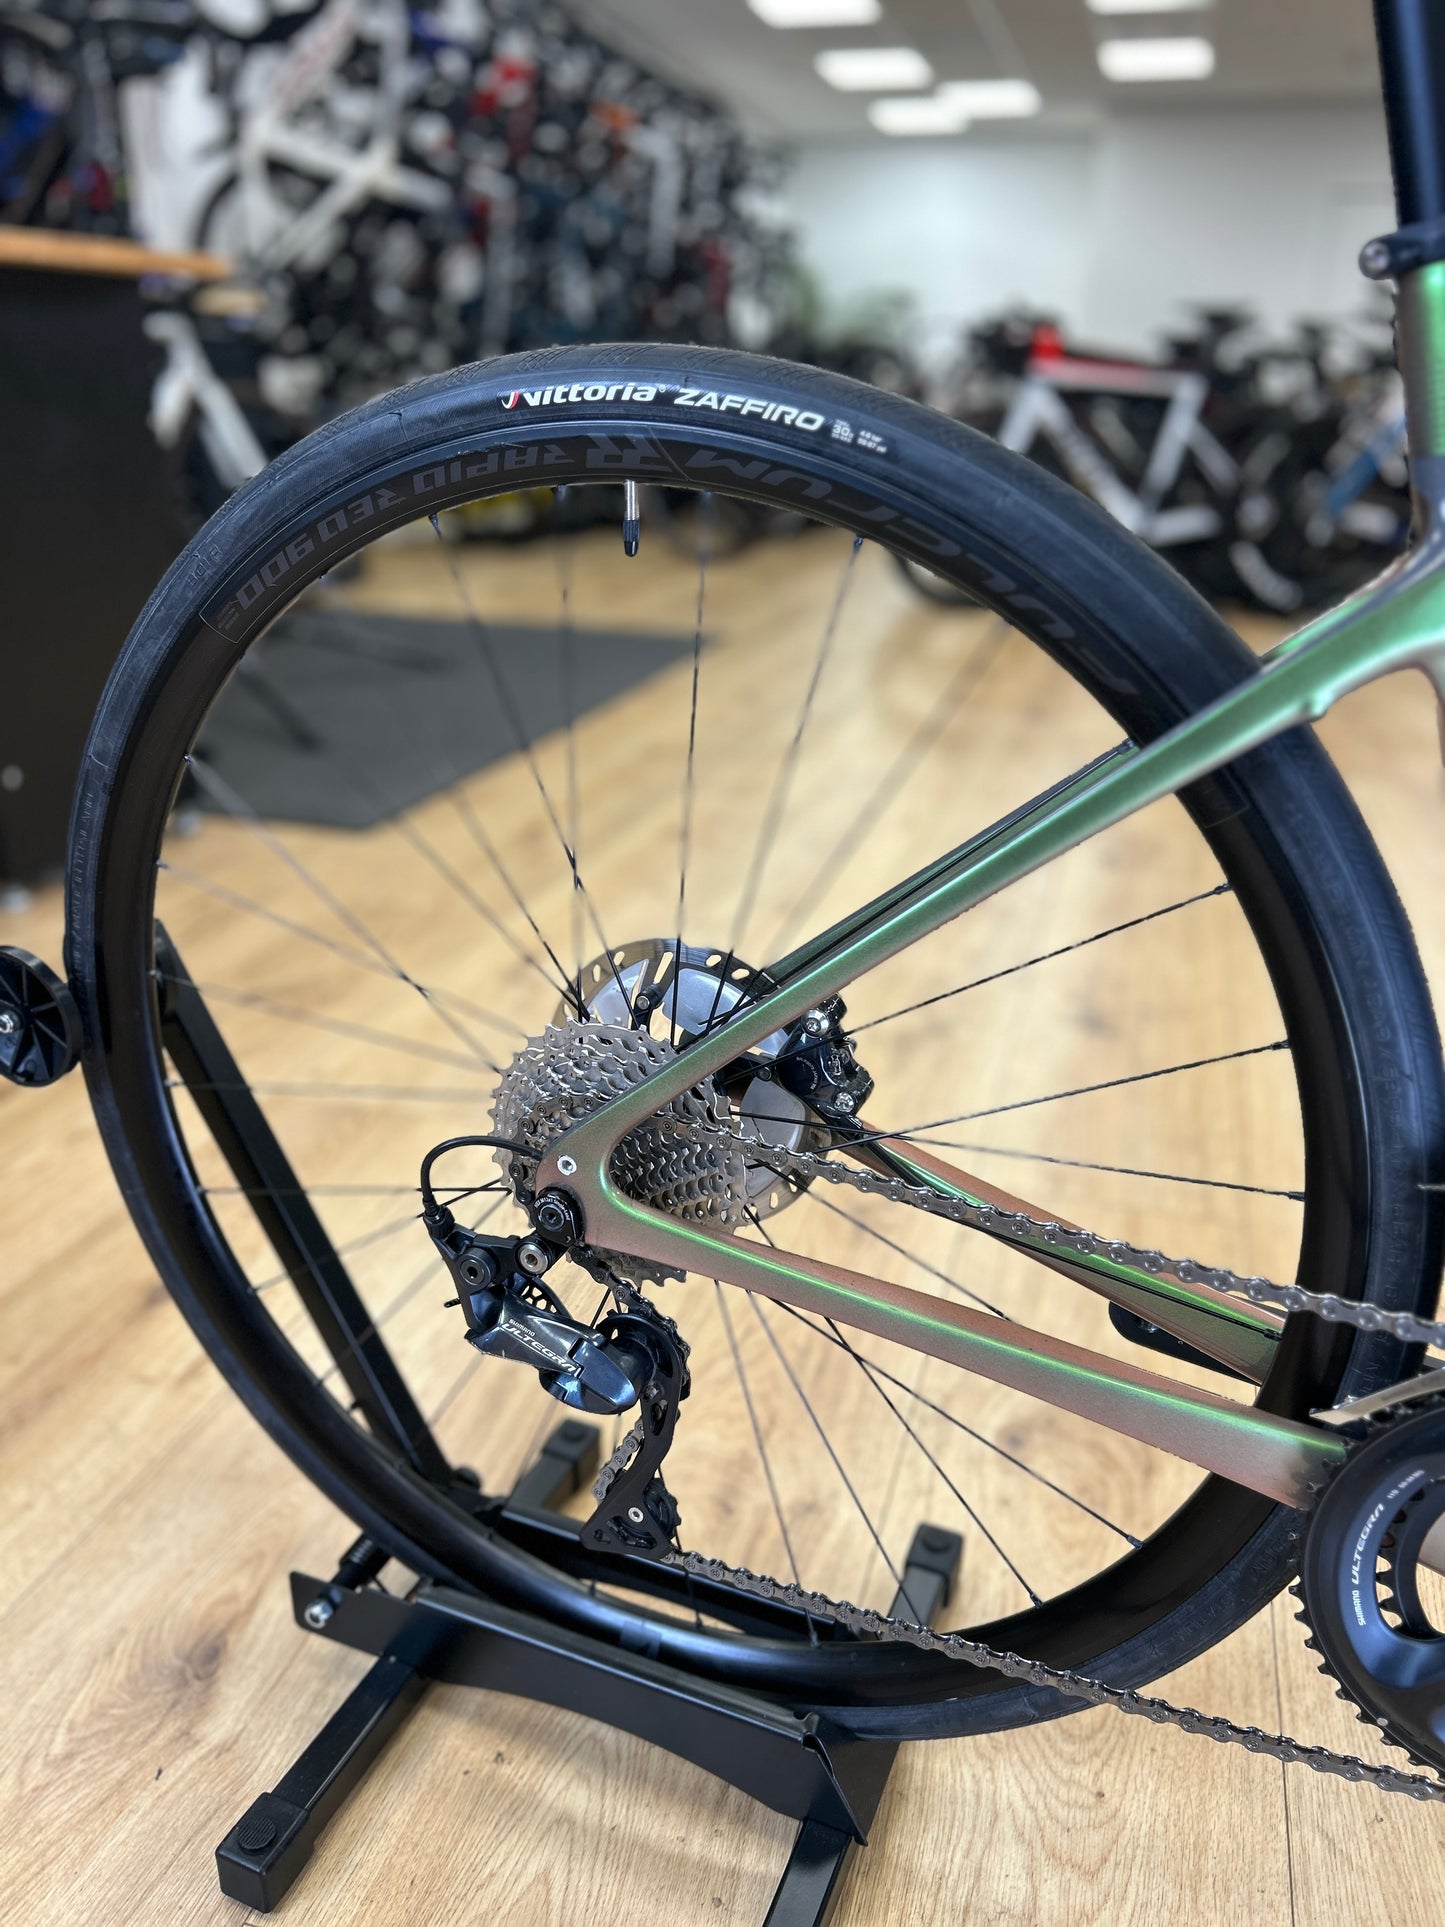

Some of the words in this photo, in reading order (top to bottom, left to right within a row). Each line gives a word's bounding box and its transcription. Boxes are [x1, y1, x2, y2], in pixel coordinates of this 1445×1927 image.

[674, 386, 825, 431] ZAFFIRO
[412, 443, 576, 495] RAPID
[316, 488, 408, 544] RED
[233, 530, 316, 605] 900
[502, 1323, 582, 1377] ULTEGRA
[508, 1318, 536, 1338] SHIMANO
[1351, 1503, 1384, 1585] ULTEGRA
[1352, 1589, 1366, 1626] SHIMANO
